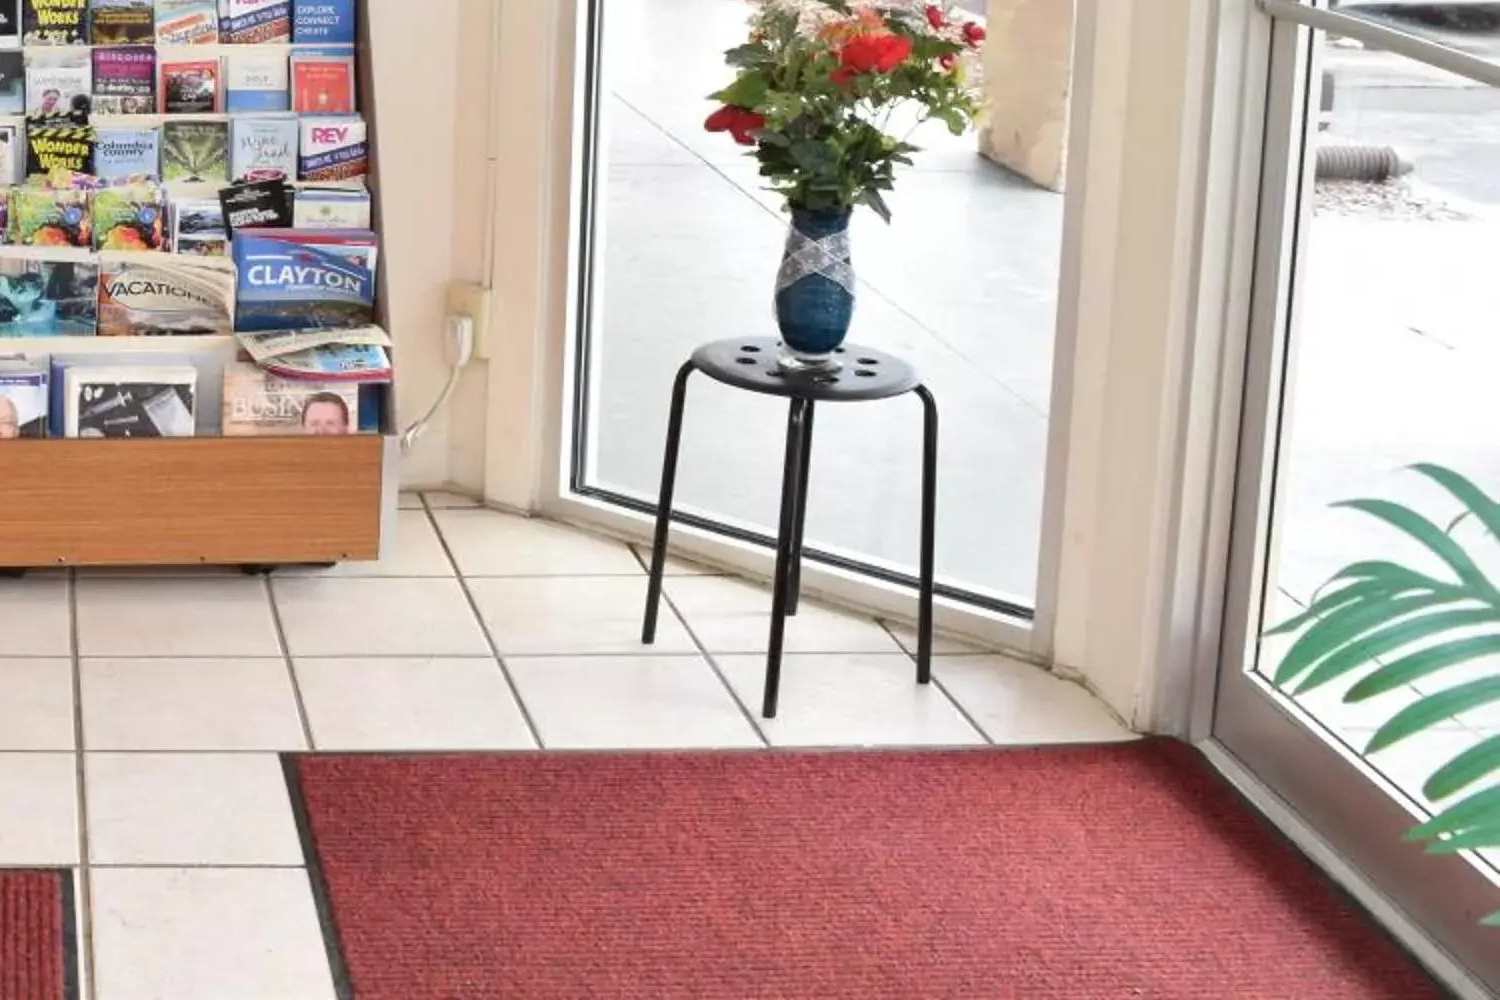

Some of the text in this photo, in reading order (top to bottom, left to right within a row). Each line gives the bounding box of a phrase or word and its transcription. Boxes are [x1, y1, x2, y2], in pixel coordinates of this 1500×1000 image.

[296, 4, 335, 15] EXPLORE
[296, 15, 341, 26] CONNECT
[311, 127, 349, 144] REV
[95, 140, 153, 151] Columbia
[102, 148, 144, 158] county
[246, 264, 361, 292] CLAYTON
[231, 394, 304, 419] BUSIN
